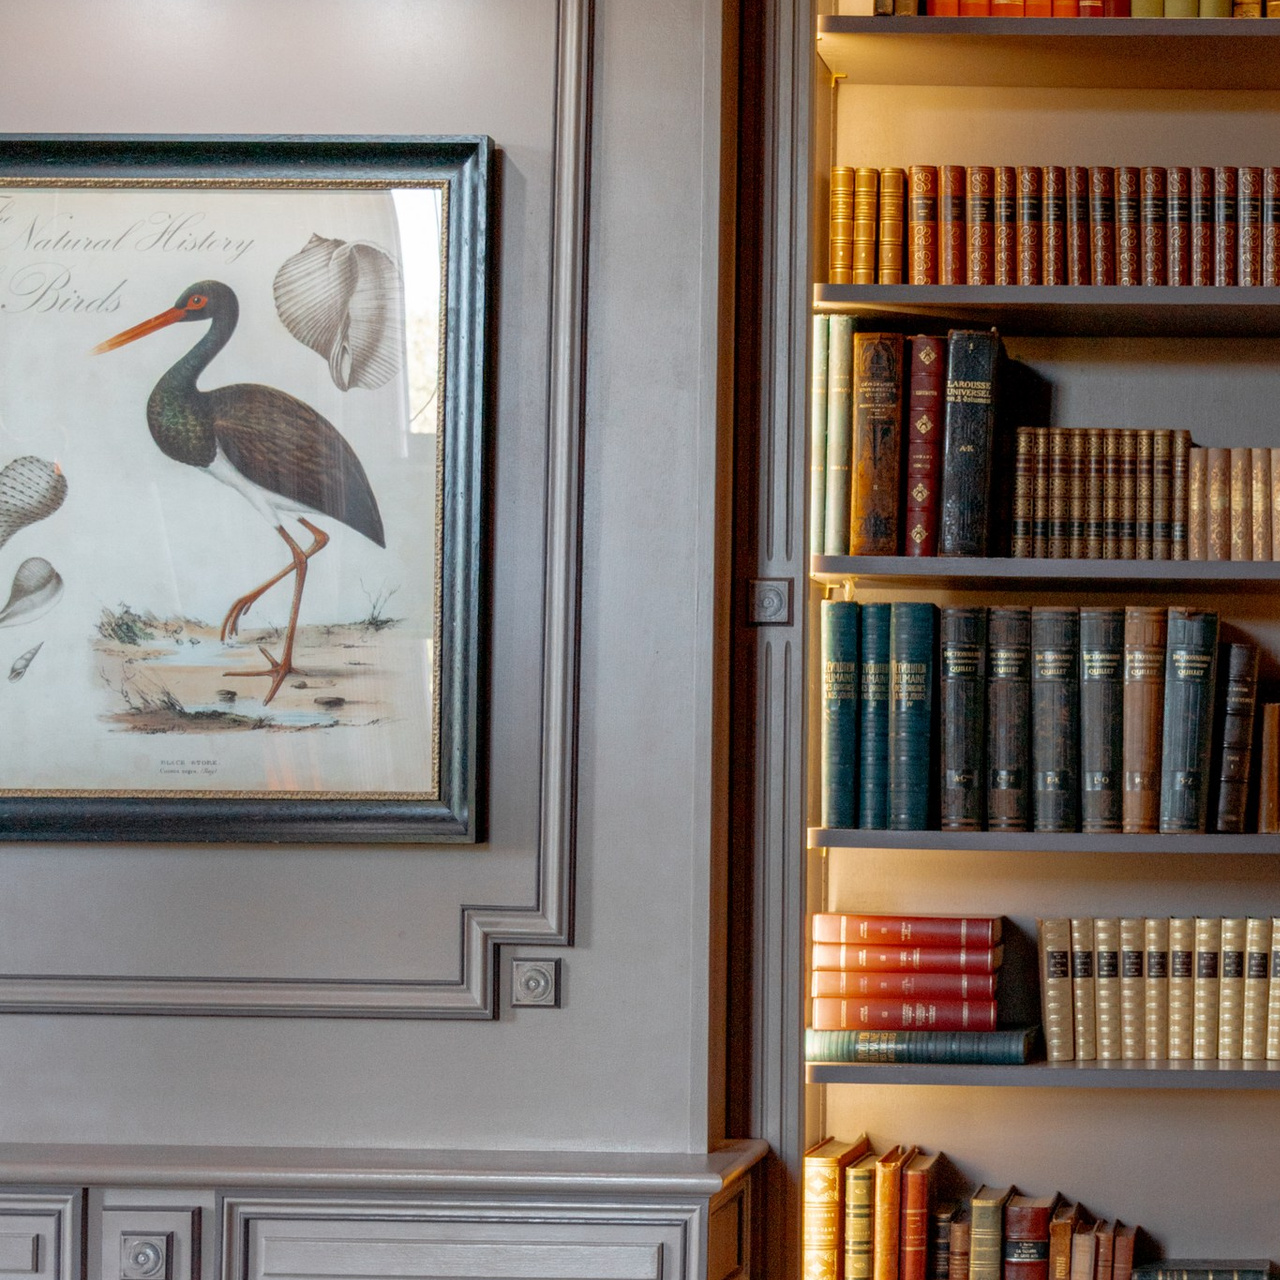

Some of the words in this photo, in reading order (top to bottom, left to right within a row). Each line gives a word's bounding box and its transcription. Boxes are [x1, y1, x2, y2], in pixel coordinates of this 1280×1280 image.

[4, 213, 145, 252] Natural
[136, 212, 255, 265] History
[4, 262, 128, 313] Birds
[947, 380, 991, 390] LAROUSSE
[946, 388, 992, 398] UNIVERSEL
[1172, 653, 1211, 661] DICTIONNAIRE
[950, 665, 976, 673] QUILLET
[993, 666, 1020, 674] QUILLET
[1088, 668, 1115, 676] QUILLET
[1131, 668, 1157, 676] QUILLET
[894, 674, 925, 684] HUMAINE
